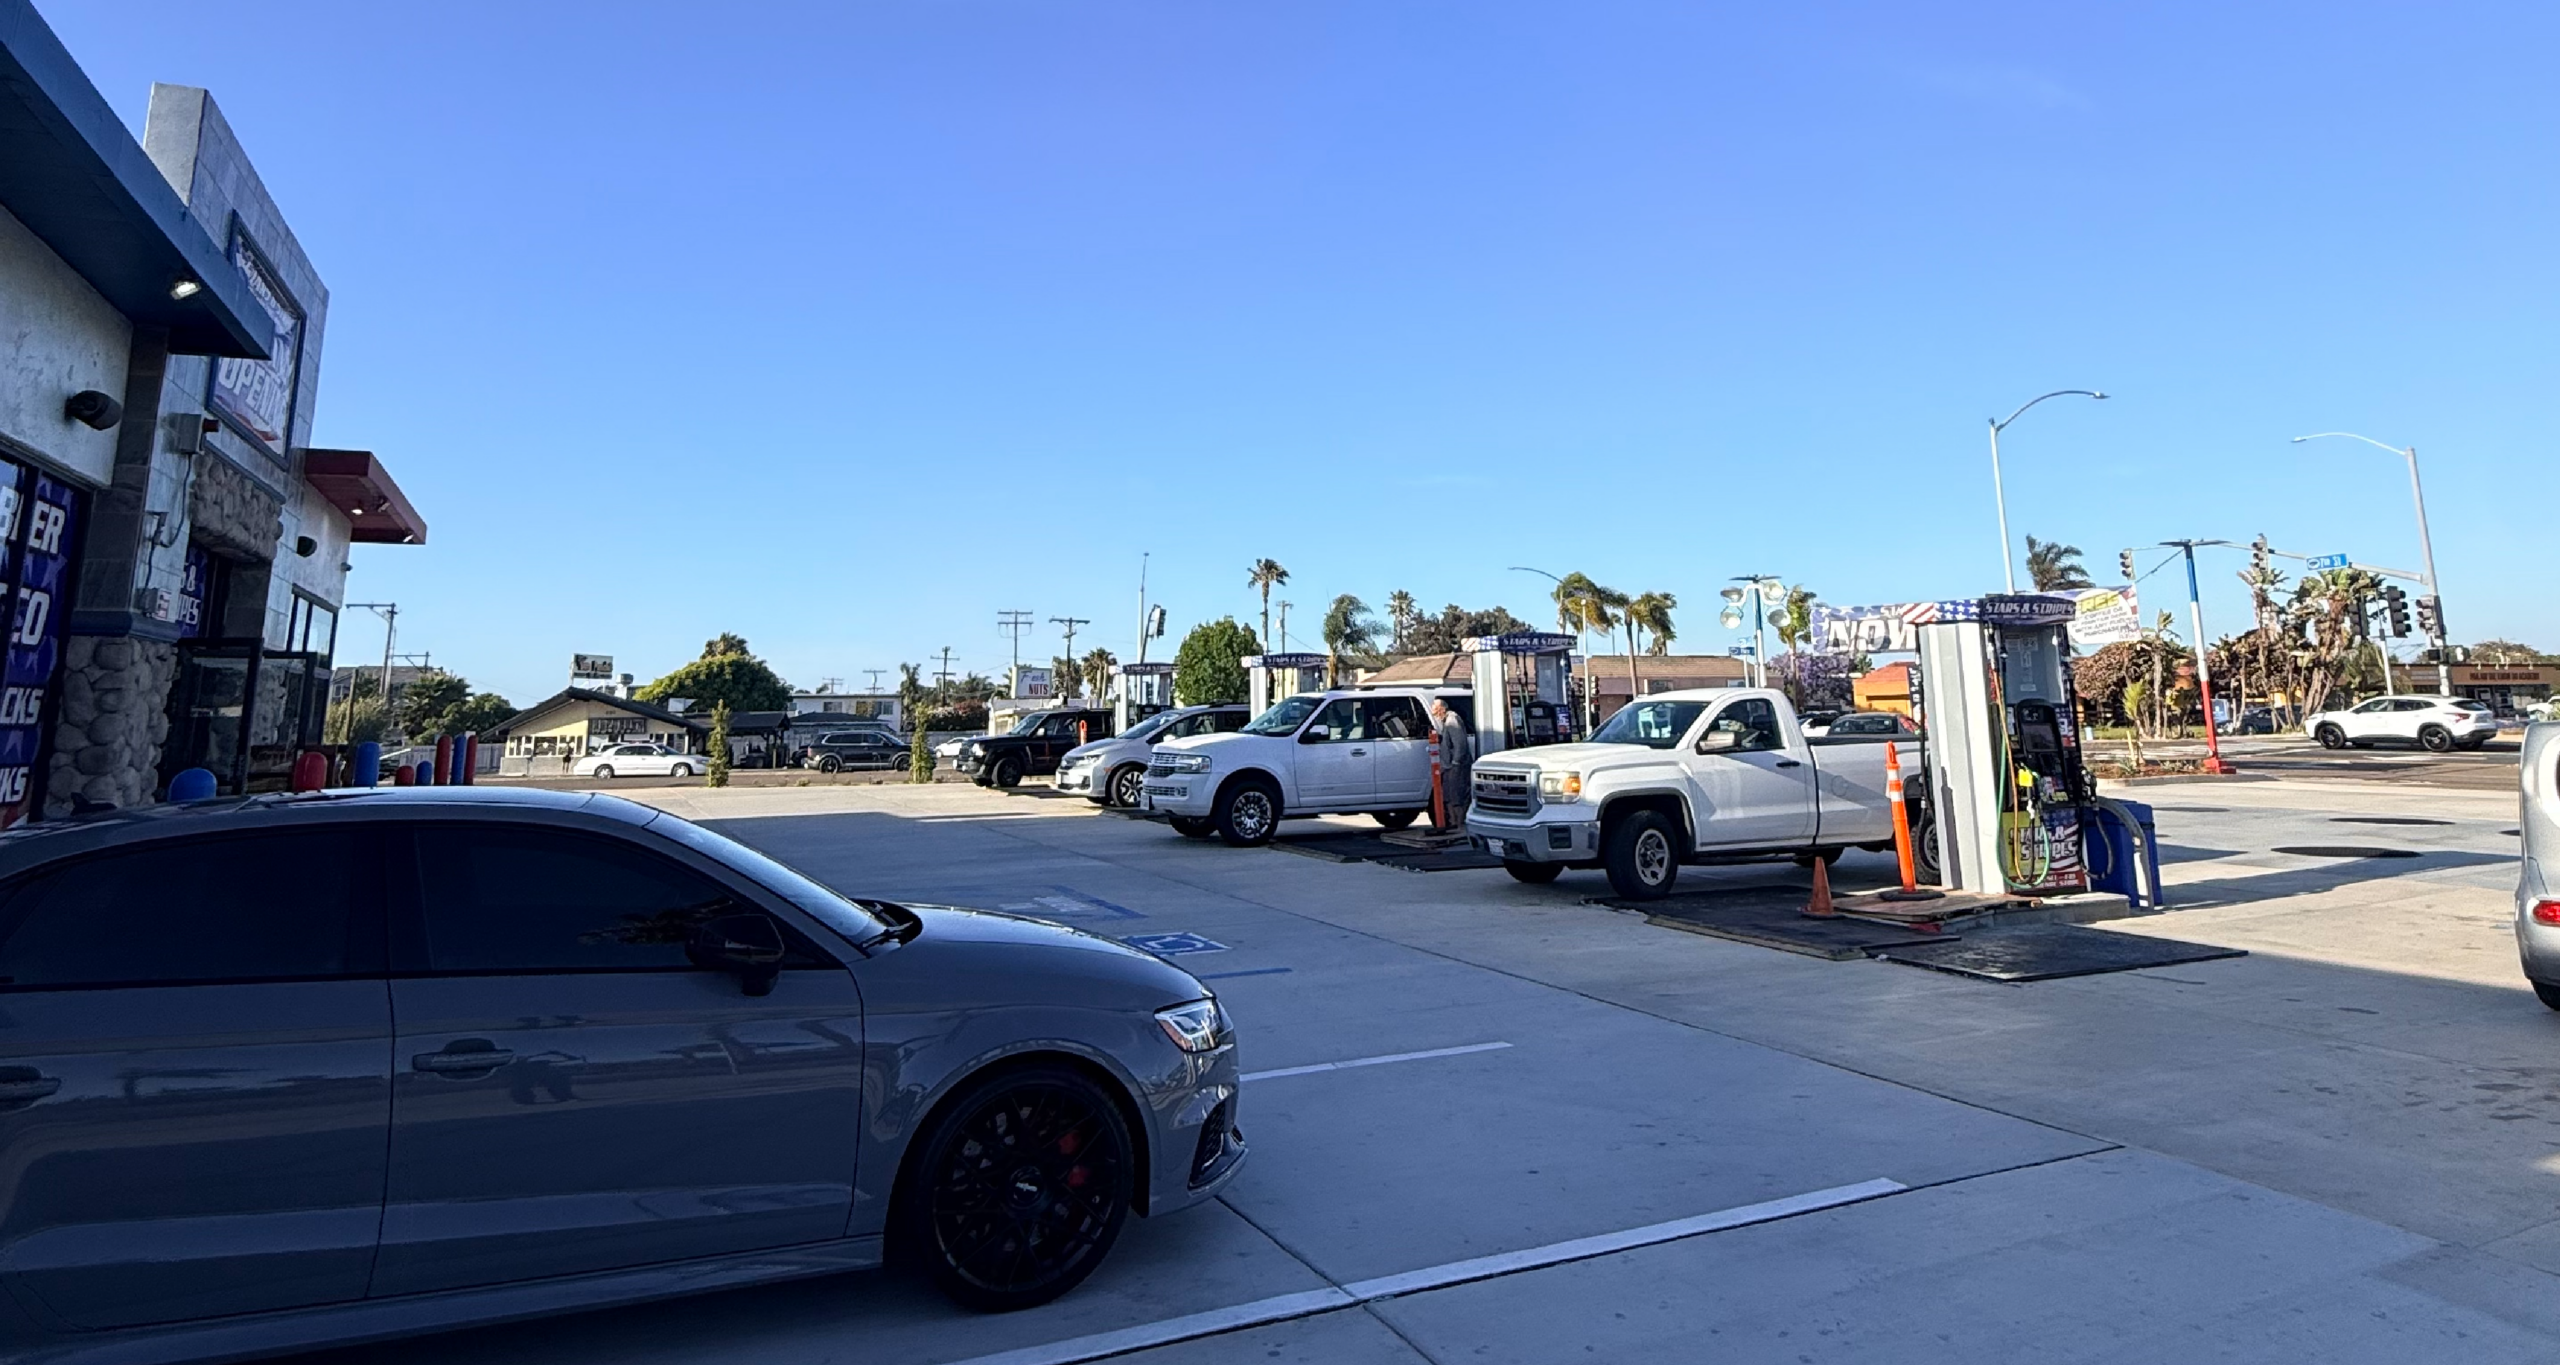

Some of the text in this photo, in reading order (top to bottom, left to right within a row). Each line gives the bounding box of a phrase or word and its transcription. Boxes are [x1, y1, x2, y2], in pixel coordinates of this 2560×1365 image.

[1985, 602, 2075, 615] STARS & STRIPES
[1028, 683, 1049, 695] NUTS
